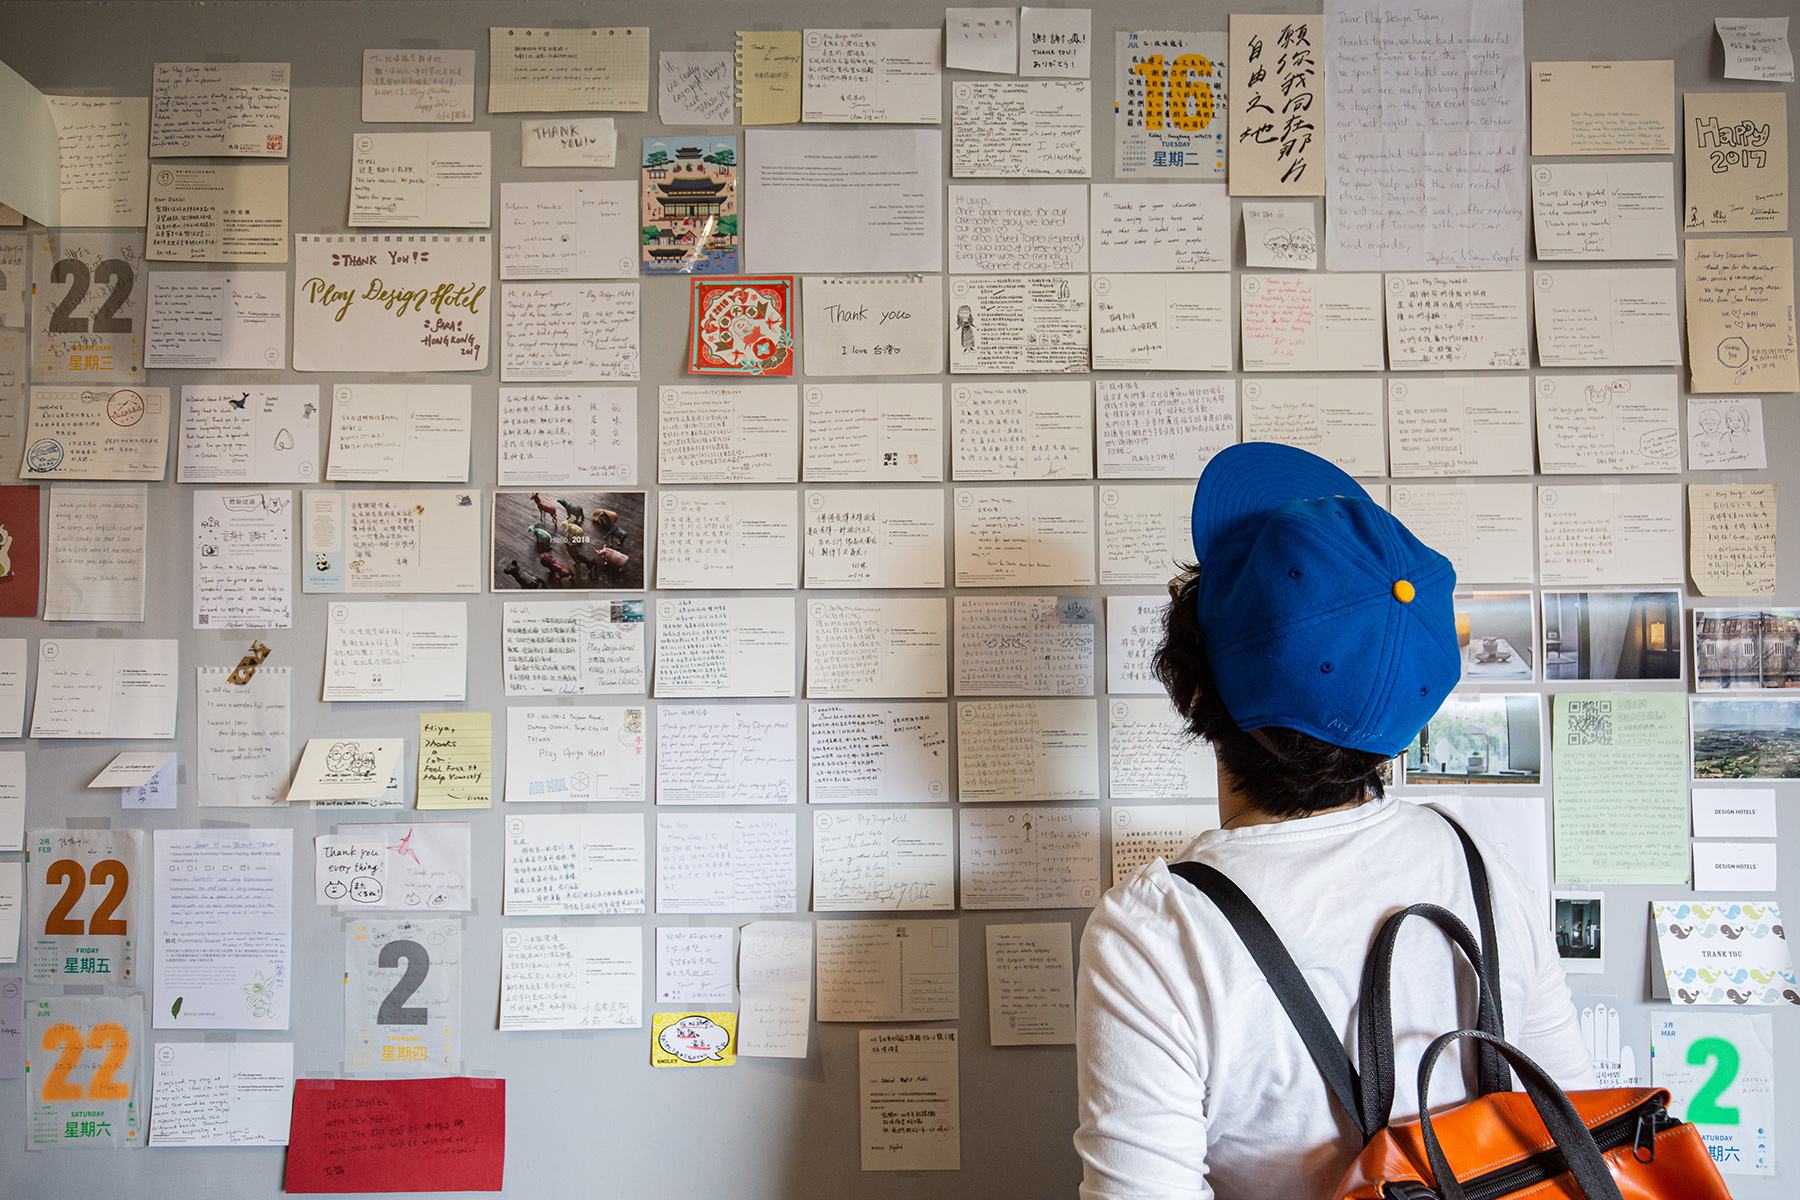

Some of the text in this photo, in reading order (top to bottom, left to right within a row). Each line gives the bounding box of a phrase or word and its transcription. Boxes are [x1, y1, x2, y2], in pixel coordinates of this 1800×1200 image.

[1338, 11, 1360, 24] Dear
[1364, 11, 1382, 30] Play
[1385, 12, 1412, 28] Design
[1337, 35, 1369, 46] Thanks
[1411, 33, 1432, 45] have
[1466, 32, 1509, 45] wonderful
[1337, 52, 1357, 62] time
[1461, 51, 1468, 60] 3
[1472, 51, 1500, 64] nights
[1352, 66, 1377, 81] spent
[1395, 69, 1410, 81] your
[1414, 66, 1437, 77] hotel
[1134, 53, 1213, 131] 16
[1239, 34, 1279, 144] 自由之地
[1337, 84, 1354, 94] and
[1399, 83, 1423, 99] really
[1427, 82, 1458, 99] looking
[1462, 81, 1498, 95] forward
[1337, 103, 1346, 111] to
[1351, 103, 1383, 118] staying
[1402, 99, 1418, 110] the
[1358, 117, 1377, 127] last
[1383, 118, 1409, 132] night
[1480, 117, 1513, 127] October
[533, 125, 579, 140] THANK
[561, 137, 587, 149] YOU!
[1055, 141, 1076, 149] LOVE
[1152, 151, 1199, 167] 星期二
[1710, 149, 1767, 173] 2017
[1041, 216, 1066, 227] loved
[1340, 238, 1362, 249] Kind
[341, 254, 377, 267] THANK
[49, 259, 134, 333] 22
[302, 277, 487, 322] Play Design Hotel
[824, 304, 868, 323] Thank
[421, 333, 476, 347] HONG KONG
[460, 344, 481, 361] 2019
[841, 346, 847, 355] I
[852, 345, 868, 354] love
[68, 355, 114, 371] 星期三
[424, 724, 456, 736] Hiya,
[425, 739, 457, 748] Thanks
[539, 748, 606, 762] Play Design Hotel
[424, 764, 442, 773] Feel
[423, 772, 446, 785] Help
[529, 778, 569, 795] AIR MAIL
[323, 845, 379, 860] Thank you
[45, 859, 129, 936] 22
[64, 958, 110, 973] 星期五
[377, 940, 430, 1025] 2
[381, 1045, 427, 1062] 星期四
[41, 1022, 130, 1102] 22
[1686, 1037, 1740, 1125] 2
[326, 1100, 349, 1111] DEAR
[64, 1121, 111, 1138] 星期六
[1708, 1145, 1740, 1162] 期六
